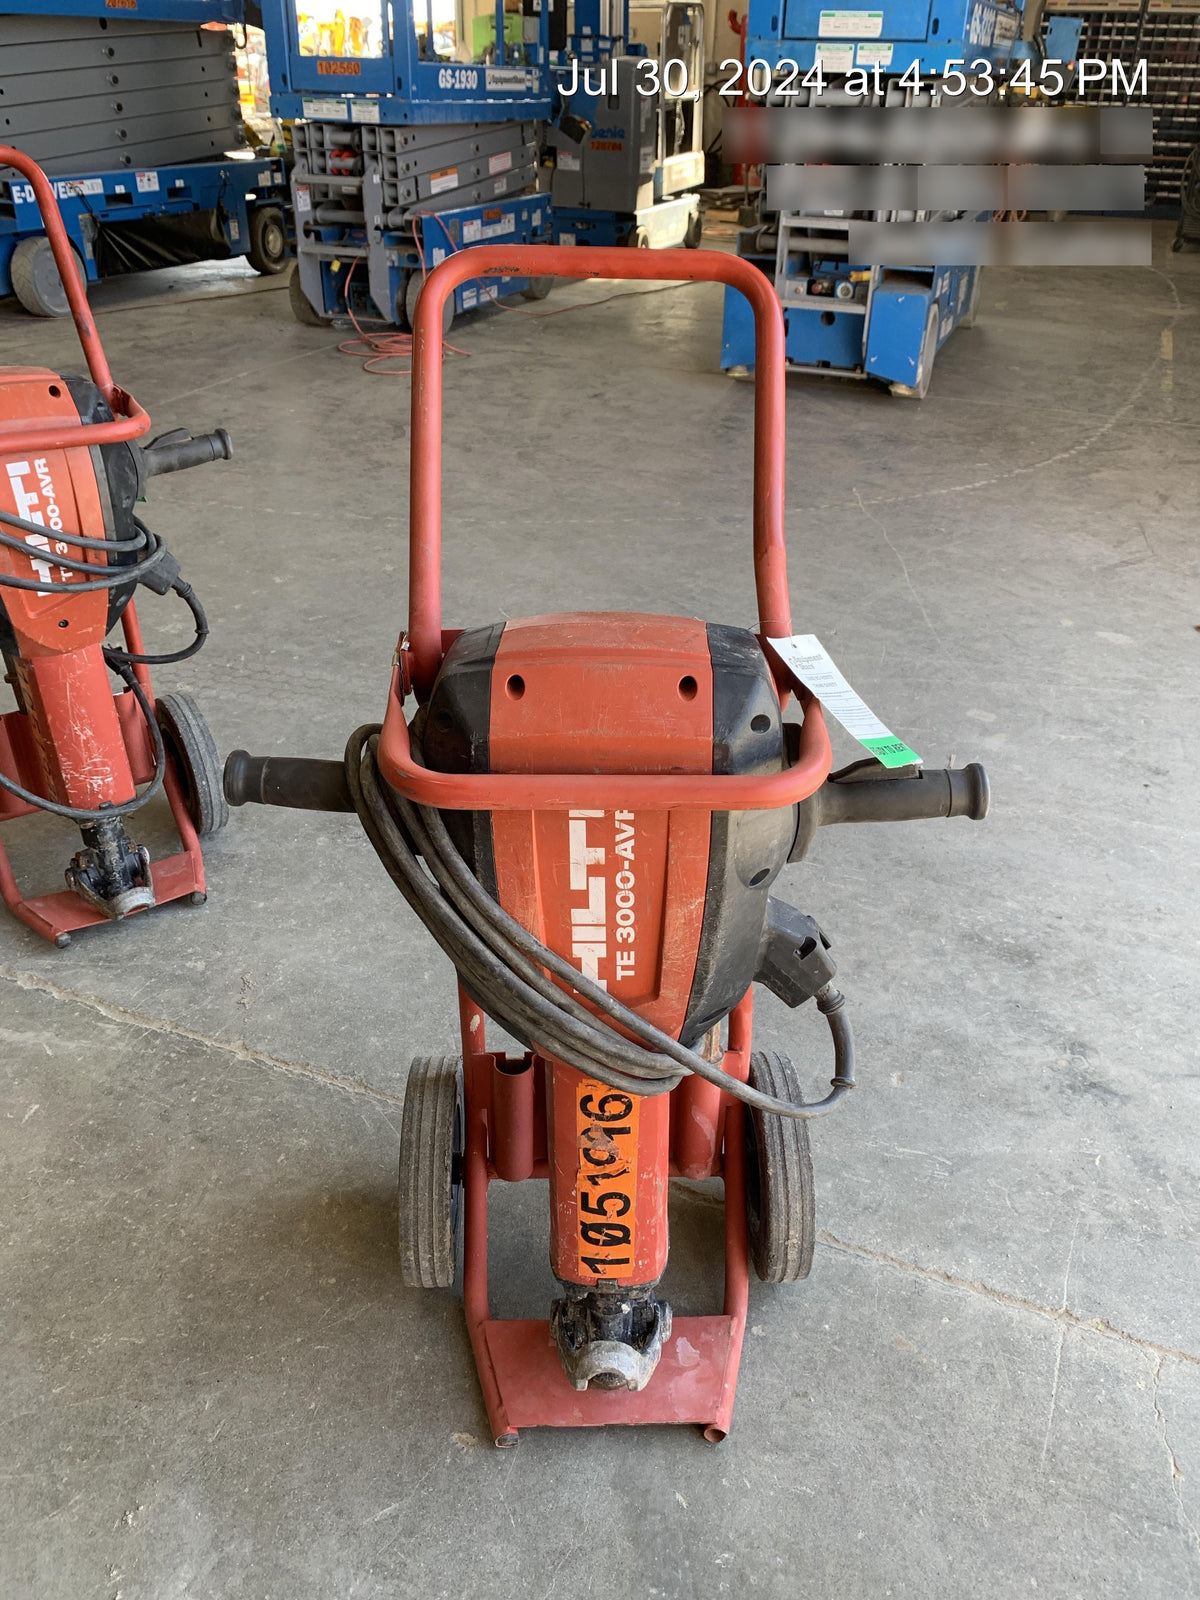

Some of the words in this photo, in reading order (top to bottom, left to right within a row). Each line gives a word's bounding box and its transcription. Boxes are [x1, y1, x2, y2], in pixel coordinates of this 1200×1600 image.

[438, 68, 478, 89] GS-1930
[11, 181, 68, 204] E-DVE
[616, 951, 636, 981] TE
